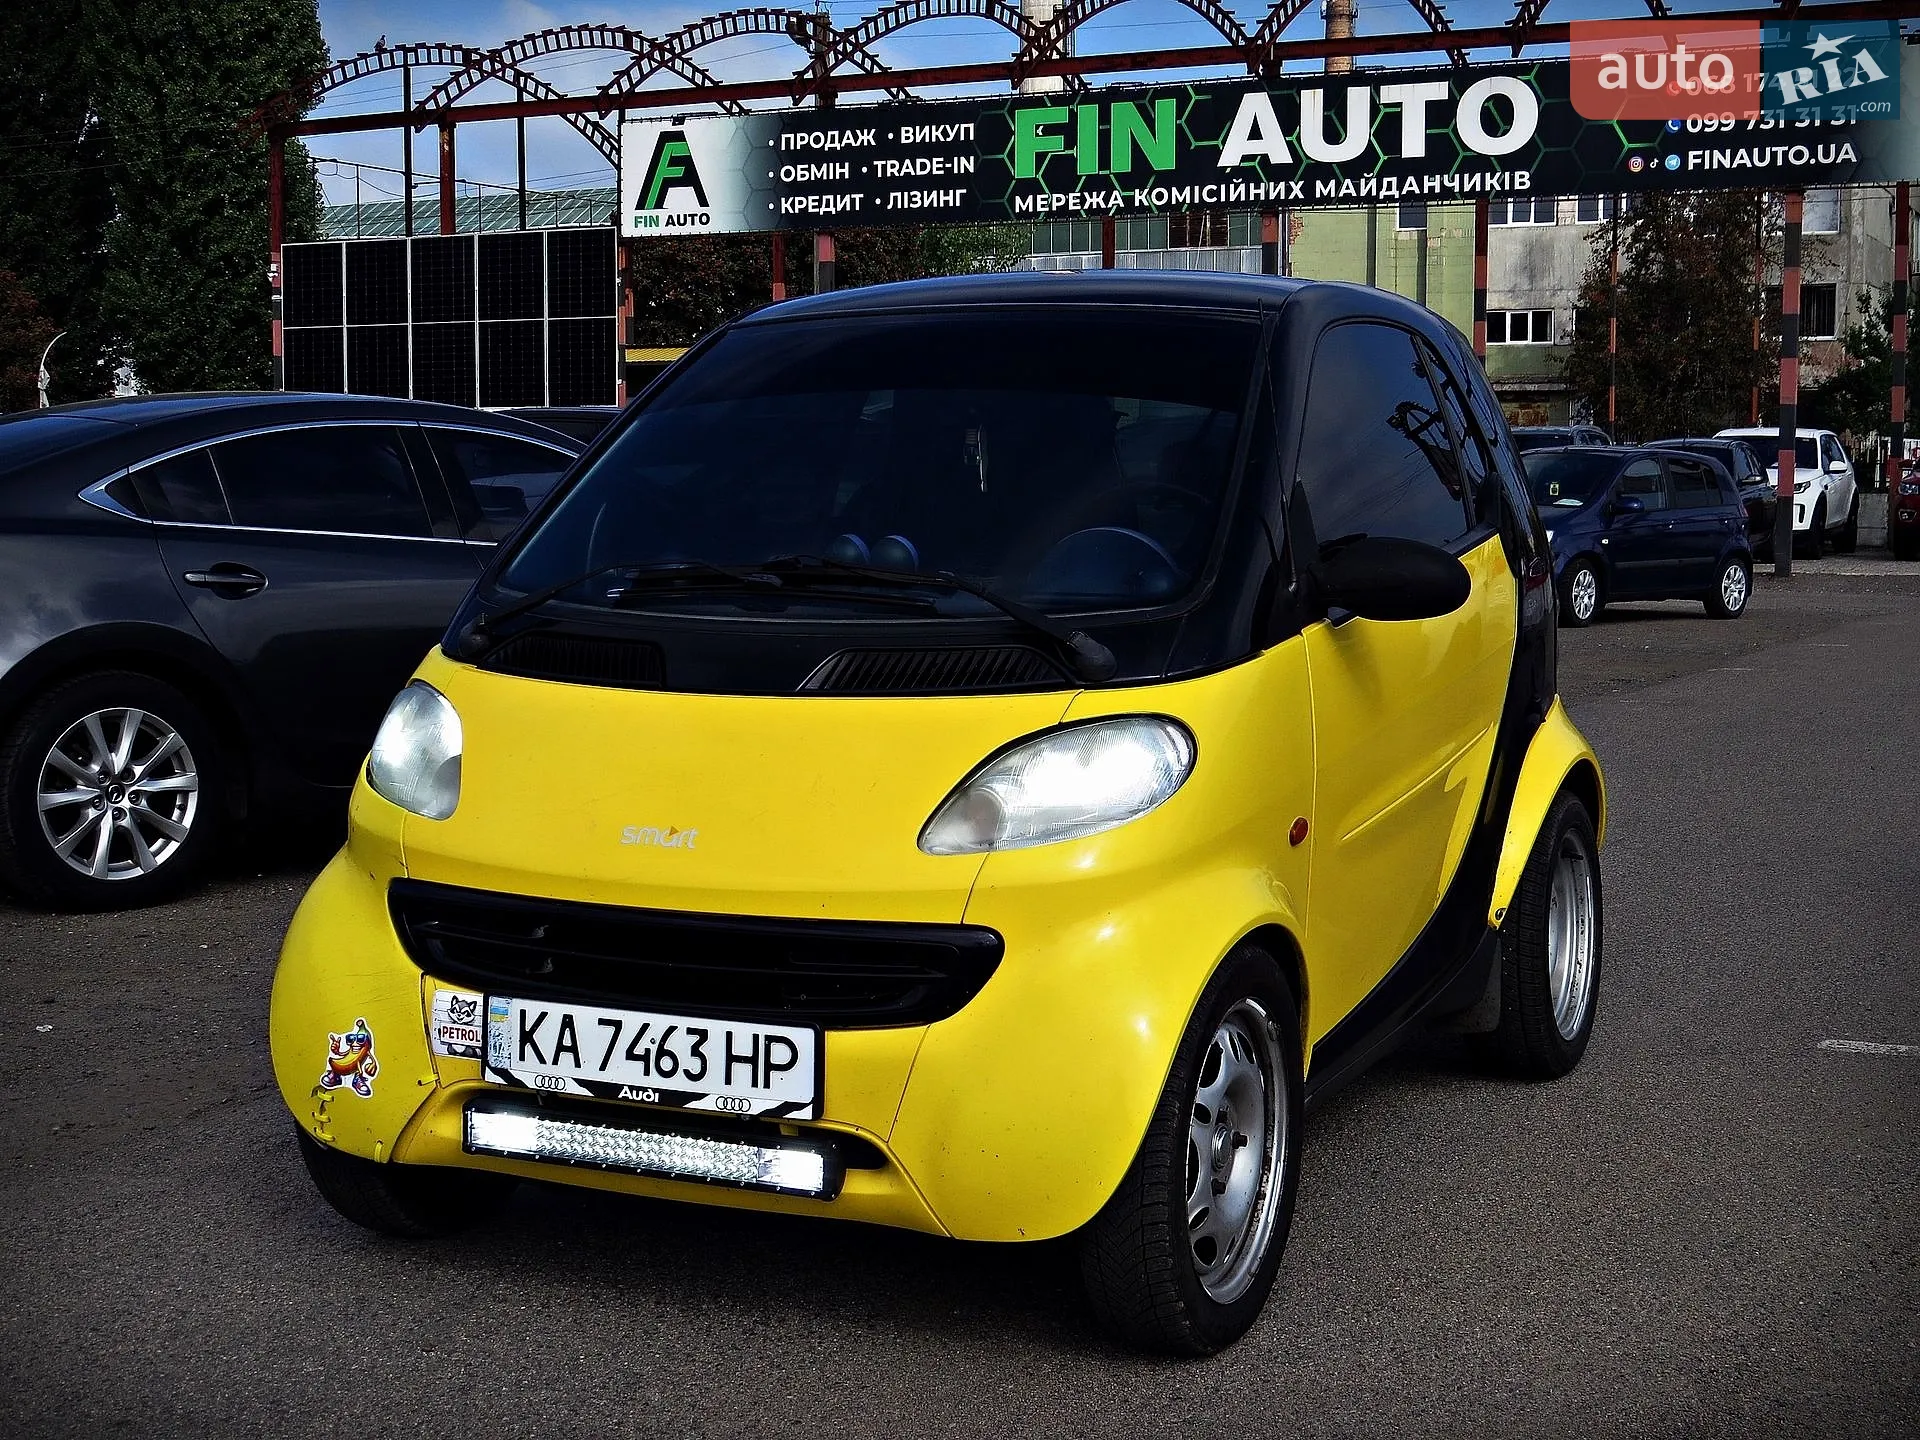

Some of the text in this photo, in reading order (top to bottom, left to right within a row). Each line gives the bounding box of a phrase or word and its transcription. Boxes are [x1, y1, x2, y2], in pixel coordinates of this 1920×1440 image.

[900, 123, 975, 144] ВИКУП
[1014, 76, 1539, 179] FIN AUTO
[1686, 111, 1736, 134] 099
[780, 128, 877, 151] ПРОДАЖ
[873, 156, 975, 178] TRADE-IN
[1687, 142, 1857, 171] FINAUTO.UA
[780, 162, 850, 183] ОБМІН
[887, 189, 967, 210] ЛІЗИНГ
[1015, 171, 1531, 214] МЕРЕЖА КОМІСІЙНИХ МАЙДАНЧИКІВ
[781, 193, 864, 216] КРЕДИТ
[634, 212, 711, 229] FIN AUTO
[620, 825, 698, 849] smart
[442, 1026, 481, 1042] PETROL
[597, 1018, 709, 1082] 7463
[618, 1085, 660, 1103] Audi
